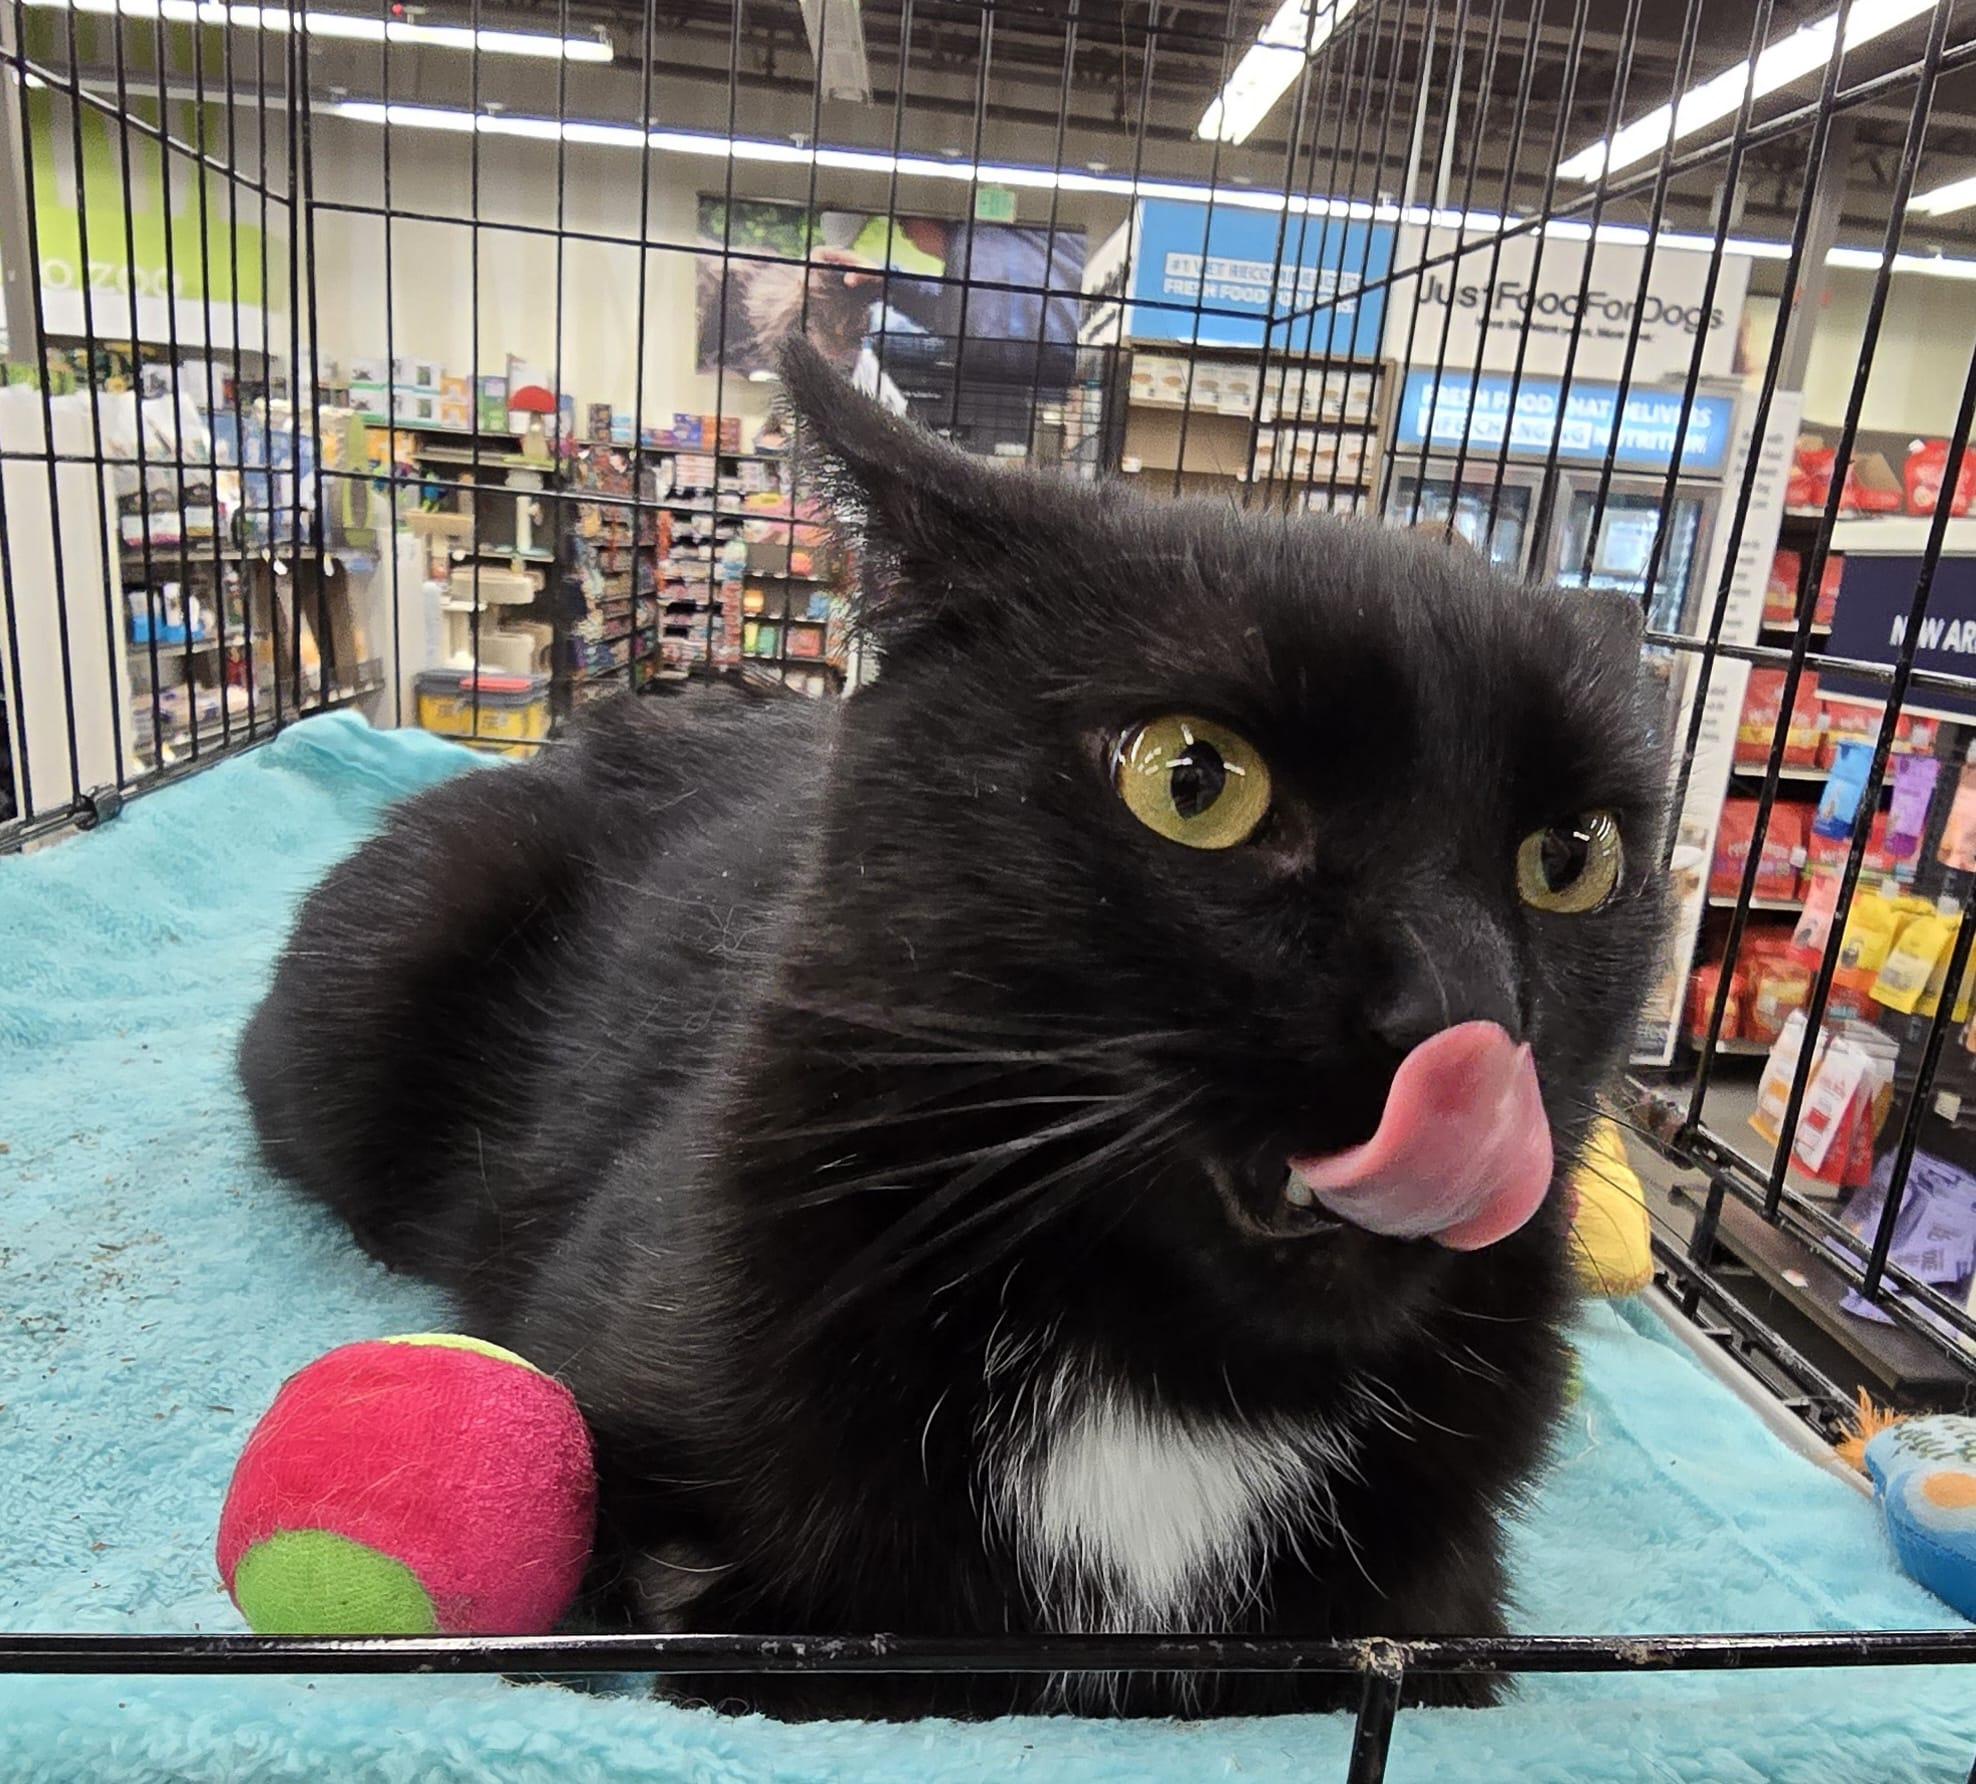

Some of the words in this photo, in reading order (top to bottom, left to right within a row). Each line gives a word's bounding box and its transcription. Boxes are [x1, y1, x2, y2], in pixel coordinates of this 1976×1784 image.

[1418, 274, 1725, 335] JusFoodForDogs
[1556, 394, 1612, 419] HAT
[1617, 400, 1713, 428] ELIVES
[1889, 614, 1946, 650] NW
